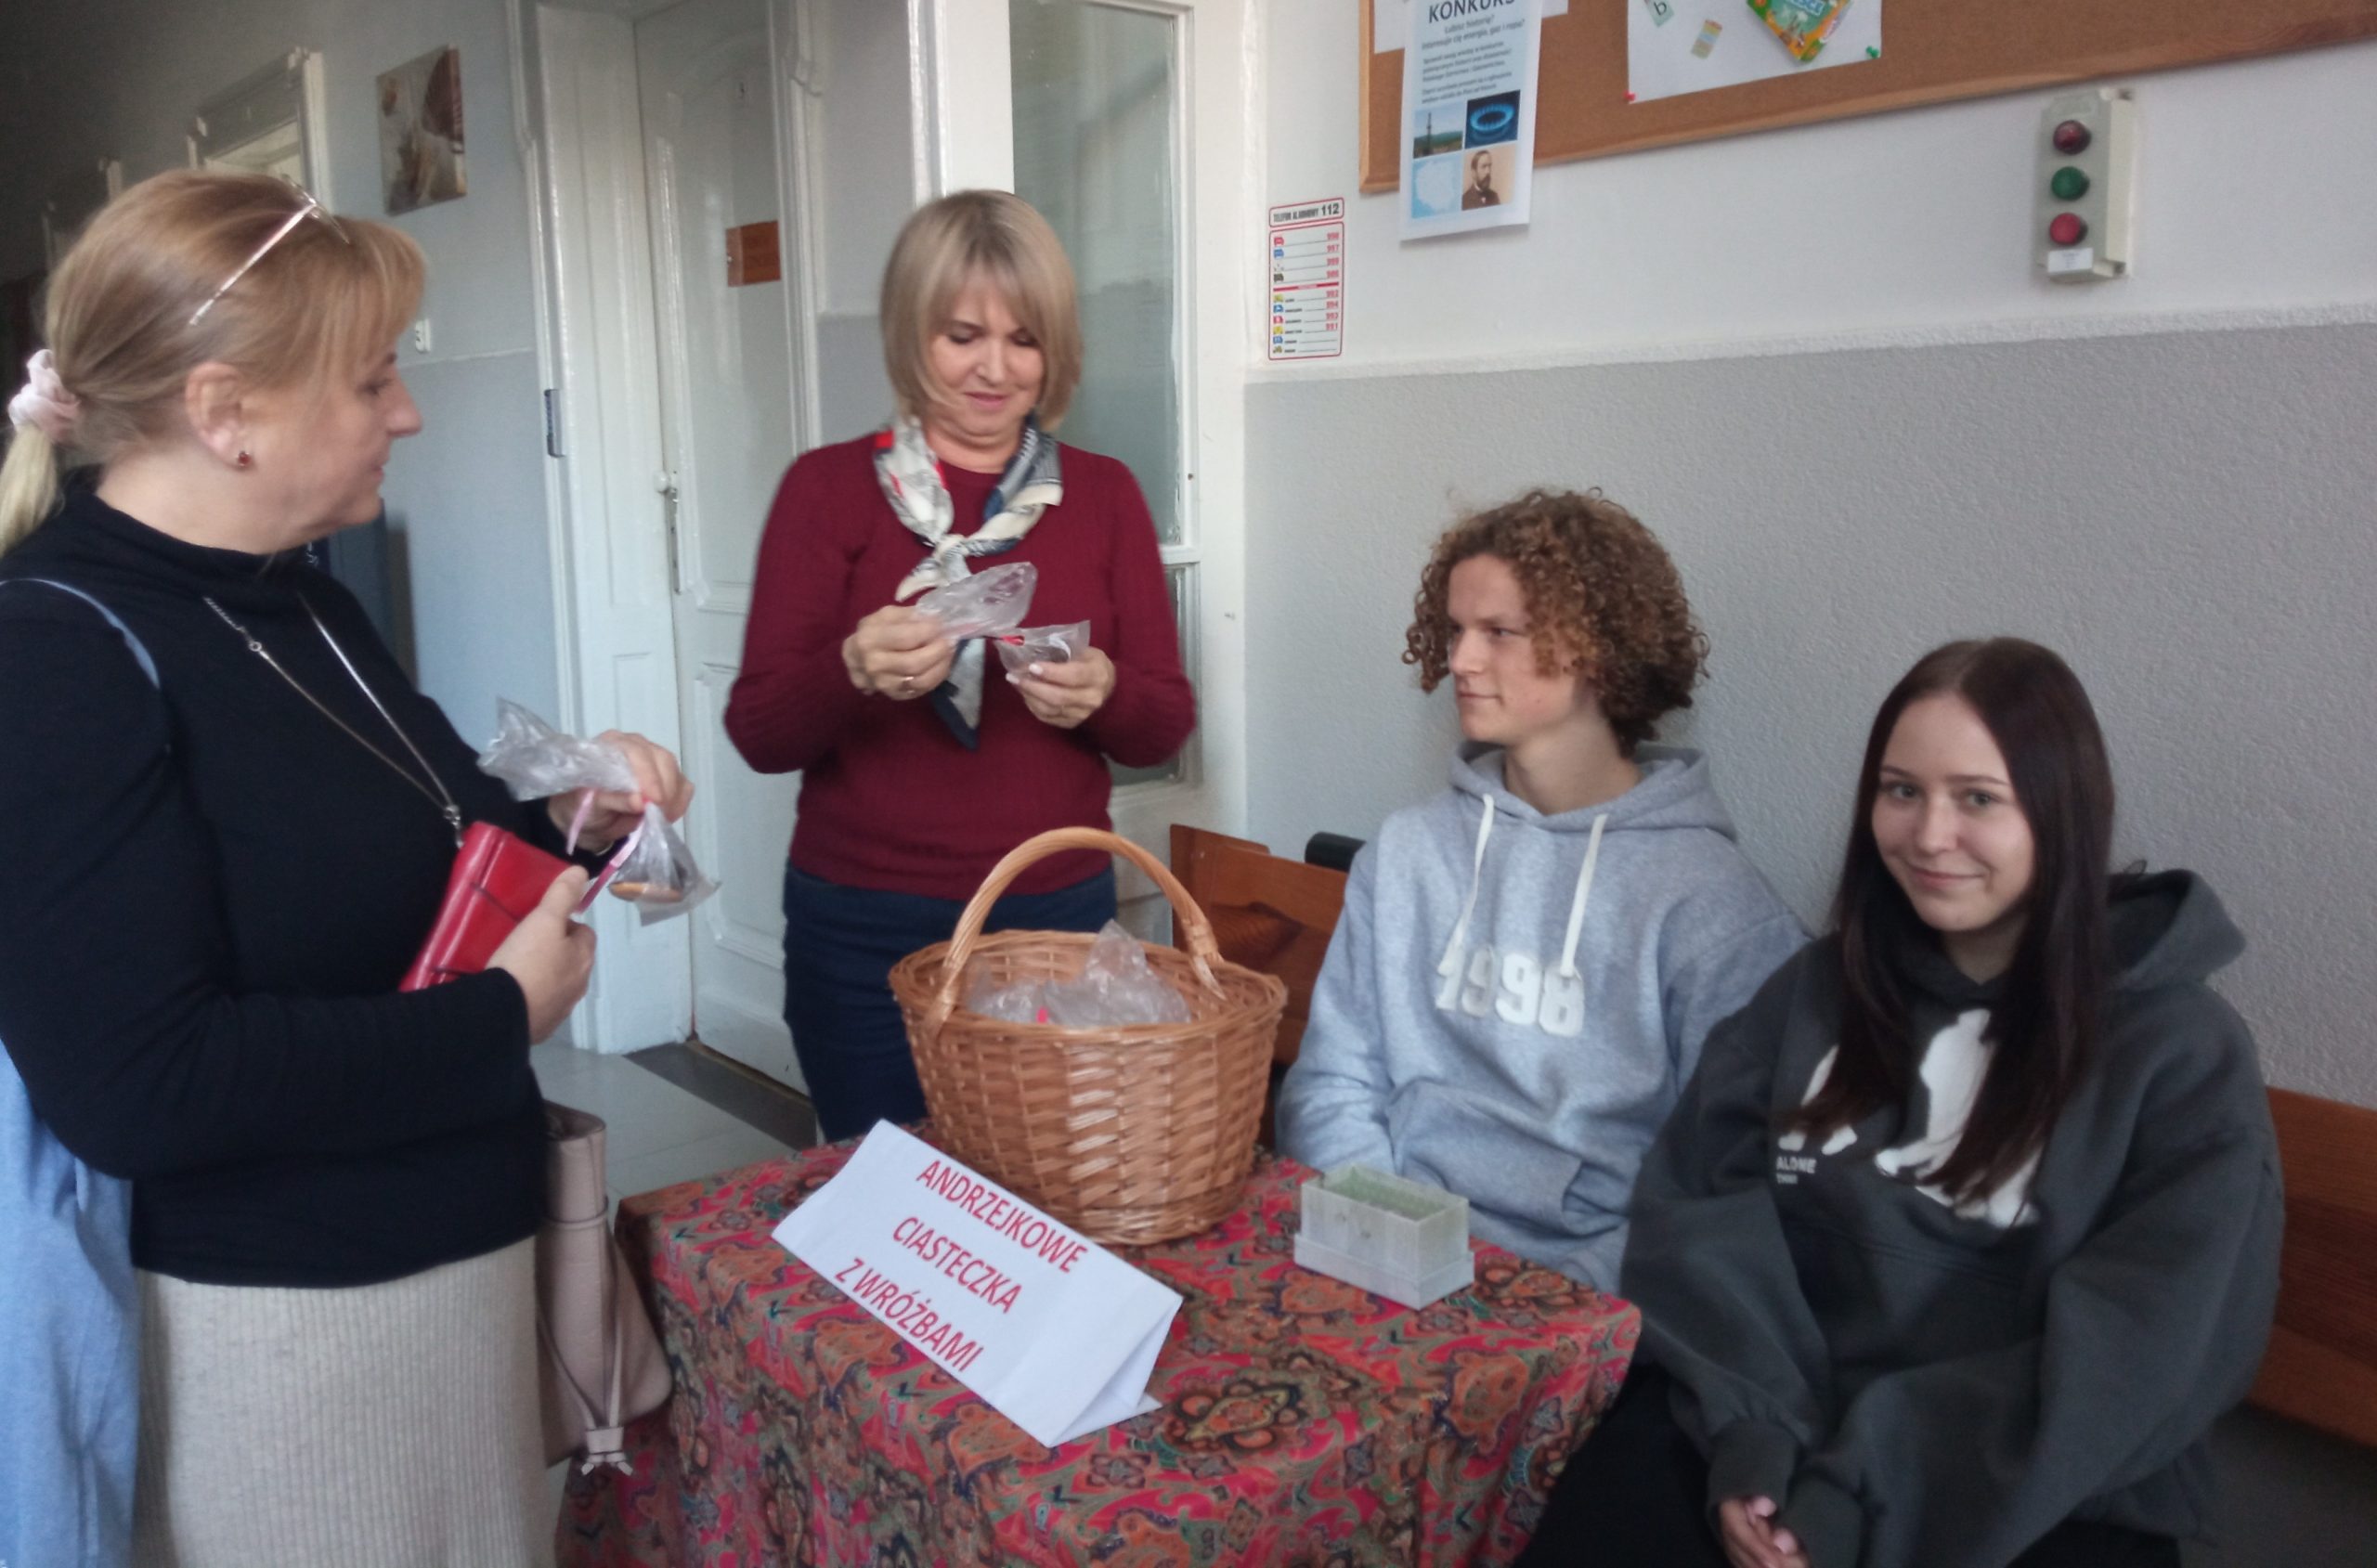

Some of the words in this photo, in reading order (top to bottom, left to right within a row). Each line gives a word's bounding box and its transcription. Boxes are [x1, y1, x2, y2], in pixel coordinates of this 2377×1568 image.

[1428, 0, 1515, 23] KONKU
[1321, 202, 1340, 216] 112
[1435, 943, 1586, 1038] 1998
[916, 1160, 1087, 1273] ANDRZEJKOWE
[893, 1217, 1022, 1314] CIASTECZKA
[836, 1257, 864, 1284] Z
[852, 1268, 984, 1372] WRÓŻBAMI
